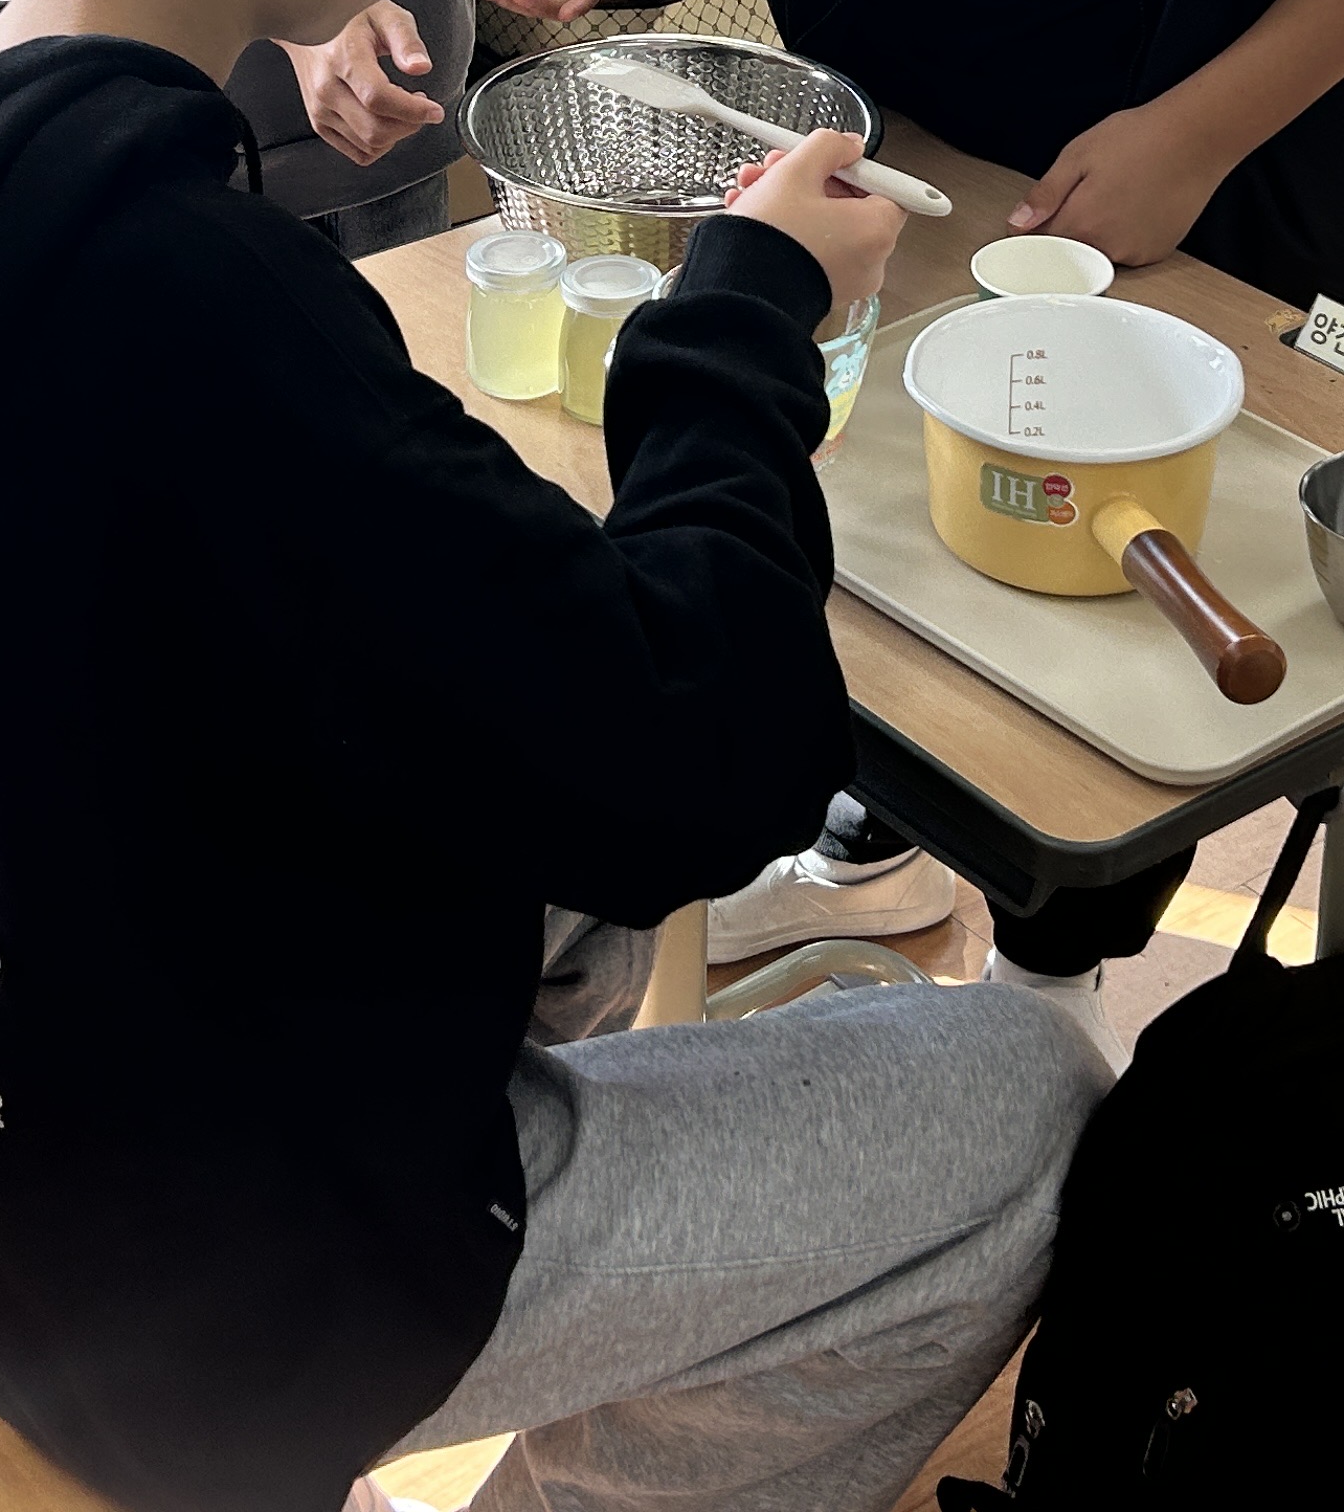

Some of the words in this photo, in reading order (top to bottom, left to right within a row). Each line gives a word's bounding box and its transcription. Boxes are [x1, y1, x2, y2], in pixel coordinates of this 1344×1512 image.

[1026, 349, 1048, 360] 0.8L
[1025, 374, 1047, 385] 0.6L
[1024, 400, 1046, 411] 0.4L
[1024, 426, 1046, 437] 0.2L
[991, 471, 1037, 511] IH
